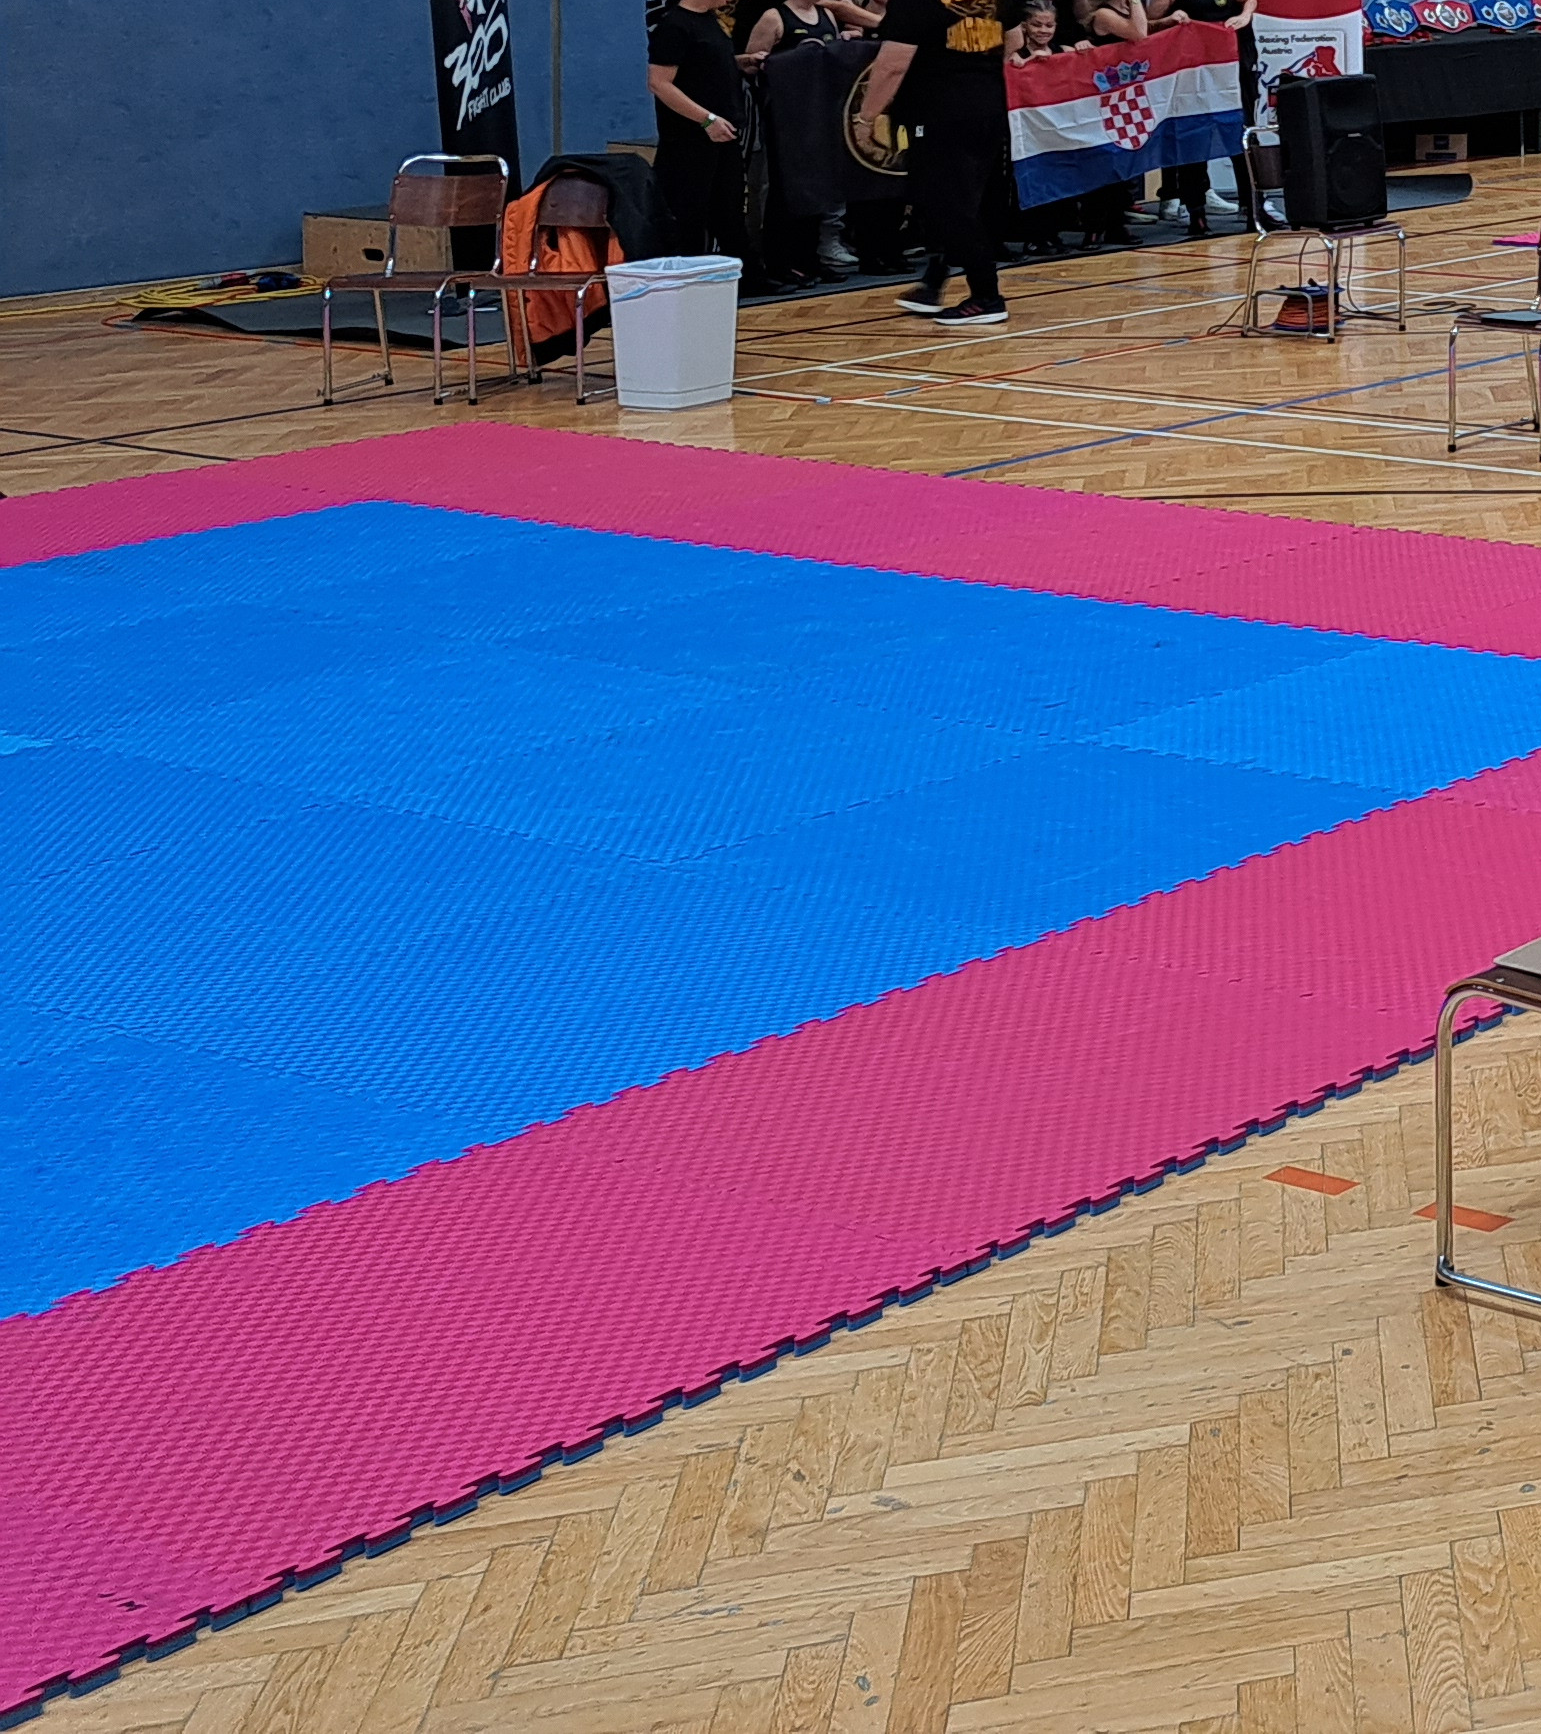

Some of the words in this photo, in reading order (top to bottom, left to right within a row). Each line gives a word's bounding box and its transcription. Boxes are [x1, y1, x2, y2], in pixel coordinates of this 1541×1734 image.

[1290, 33, 1338, 44] Federation
[1261, 46, 1293, 55] Austria
[467, 86, 490, 122] FIGHT
[489, 76, 512, 107] CLUB
